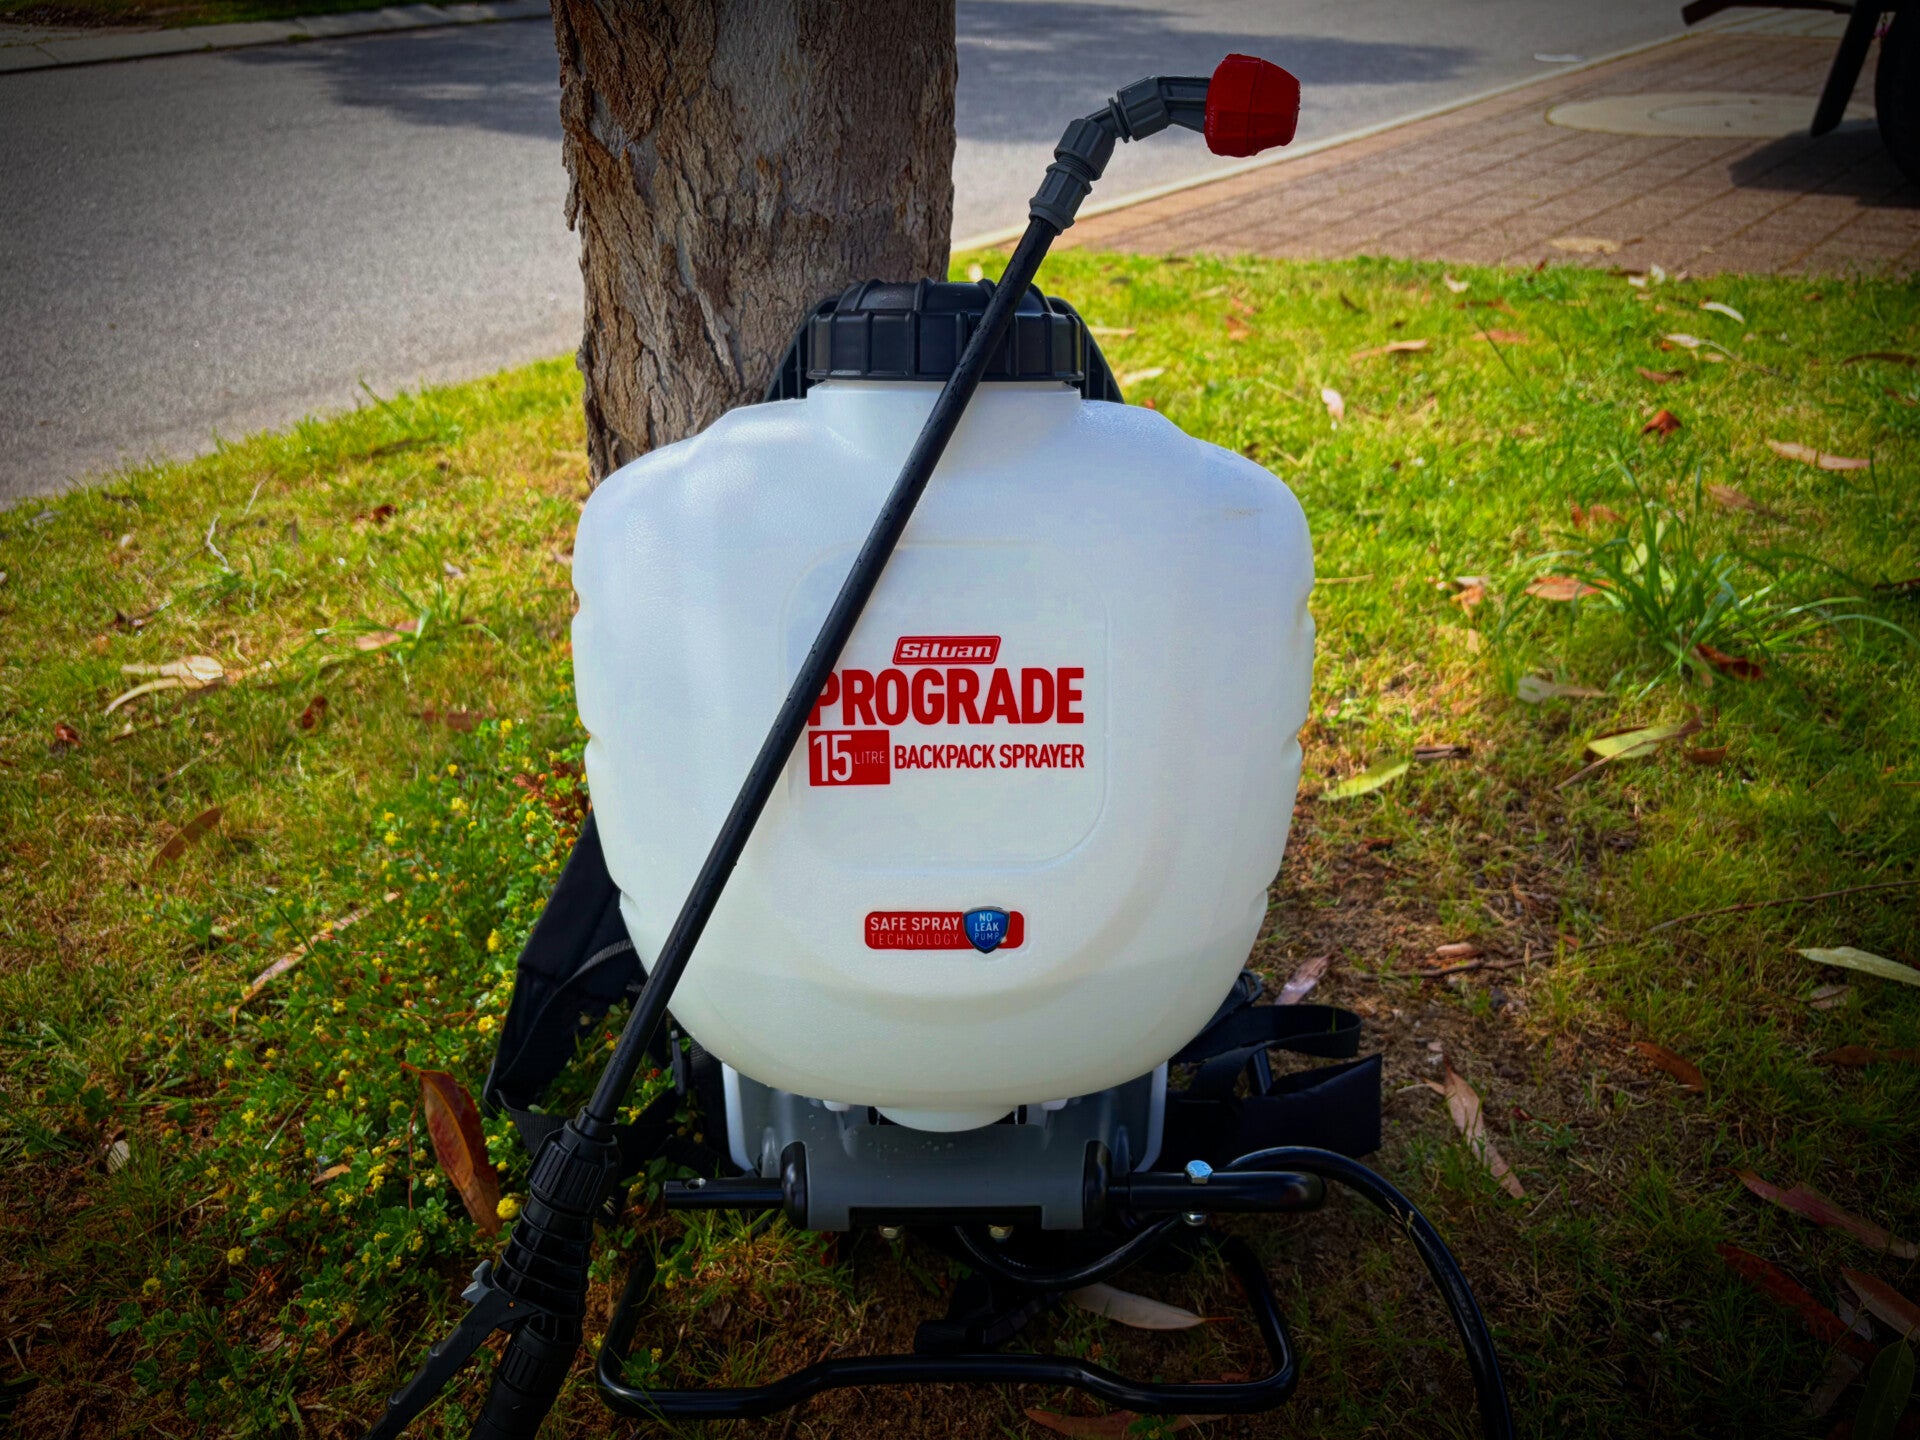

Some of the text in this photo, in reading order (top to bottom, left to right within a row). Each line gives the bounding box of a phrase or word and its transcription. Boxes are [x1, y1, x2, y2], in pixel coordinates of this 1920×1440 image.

[808, 667, 1085, 726] PROGRADE
[813, 734, 1085, 782] 15 LITRE BACKPACK SPRAYER
[870, 917, 960, 931] SAFE SPRAY
[979, 913, 993, 922] NO
[974, 922, 1000, 932] LEAK
[871, 933, 959, 946] TECHNOLOGY
[974, 932, 1000, 941] PUMP
